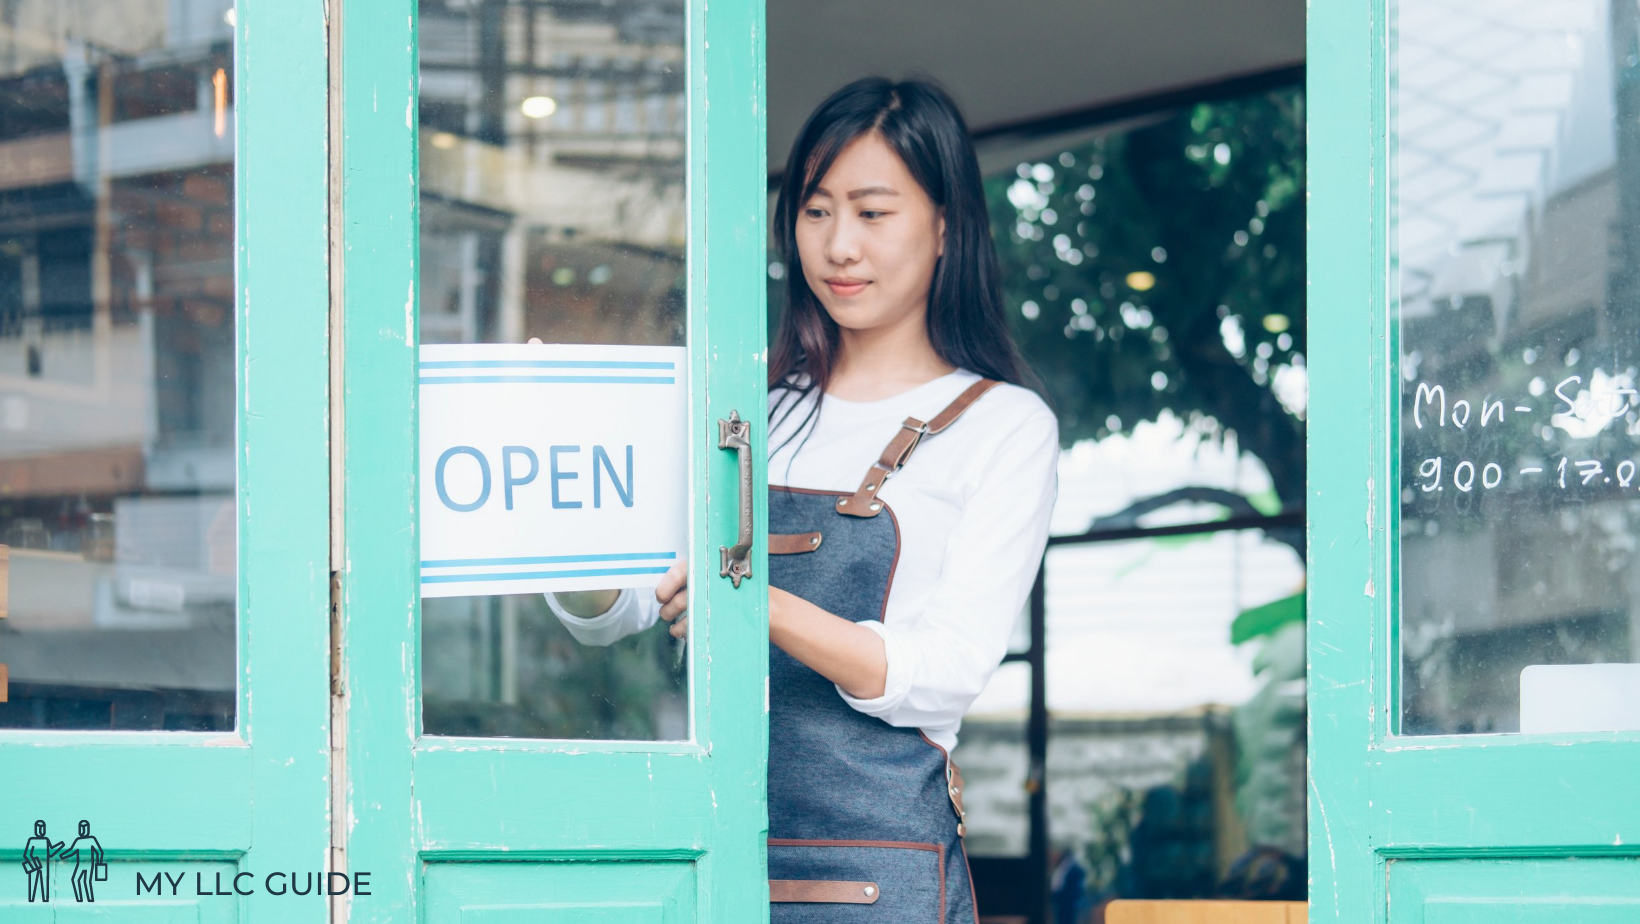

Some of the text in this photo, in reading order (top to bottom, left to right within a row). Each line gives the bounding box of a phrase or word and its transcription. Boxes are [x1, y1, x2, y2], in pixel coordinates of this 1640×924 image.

[434, 444, 634, 513] OPEN
[1418, 456, 1502, 492] 9.00
[1557, 456, 1640, 490] 17.0
